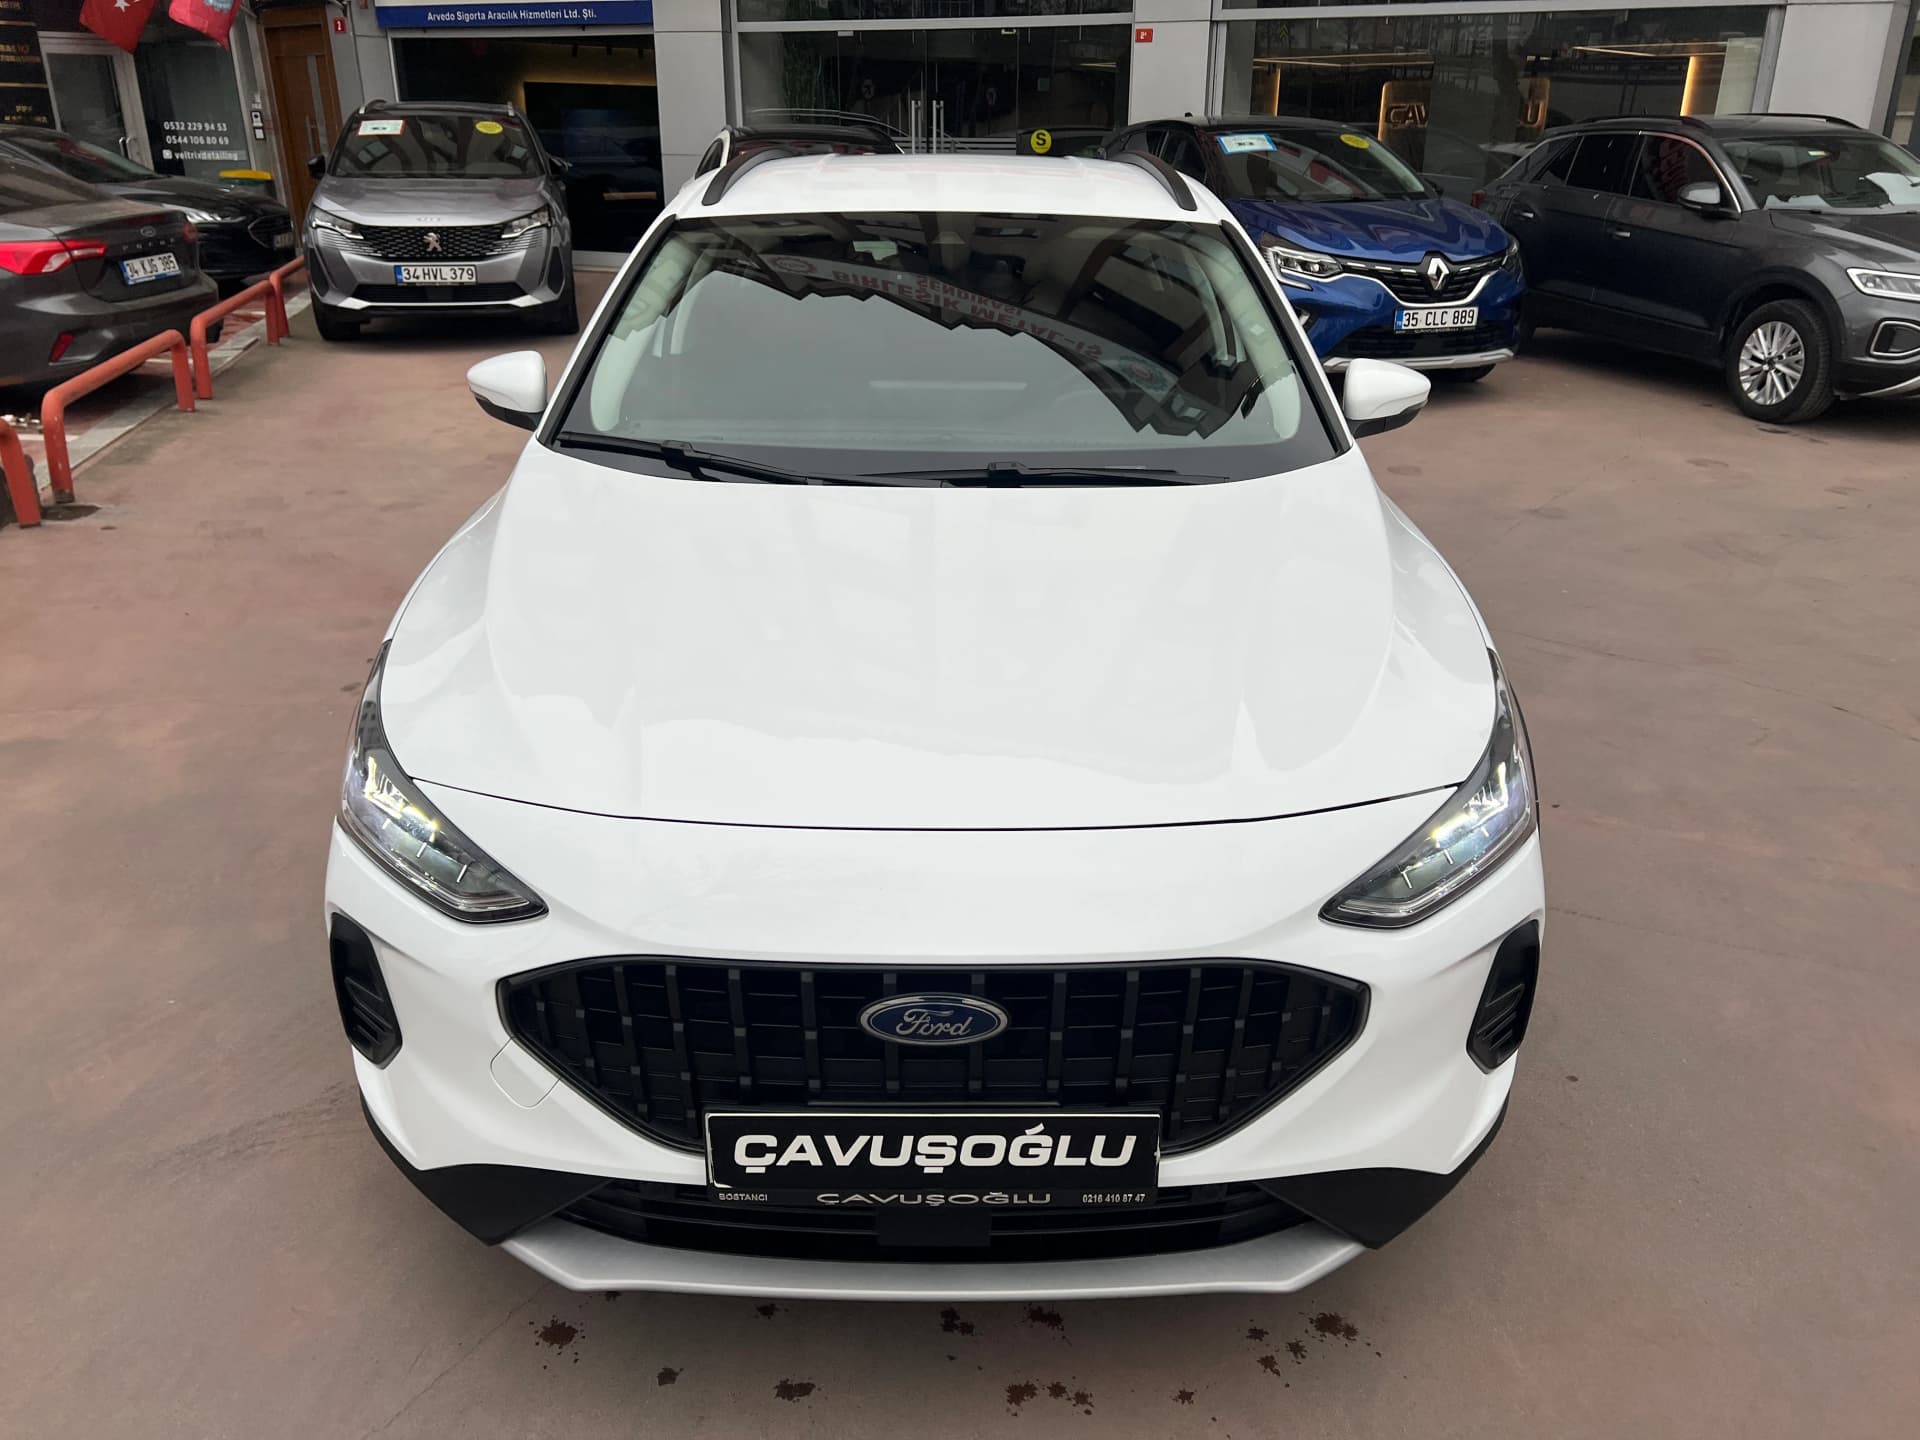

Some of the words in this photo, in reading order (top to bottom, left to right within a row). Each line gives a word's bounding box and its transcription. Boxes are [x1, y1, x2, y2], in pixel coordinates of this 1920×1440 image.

[427, 11, 455, 21] Arvedo
[456, 10, 486, 22] Sigorta
[487, 9, 519, 20] Aracılık
[519, 9, 562, 20] Hizmetleri
[563, 8, 581, 19] Ltd.
[582, 8, 598, 20] Şti.
[163, 121, 185, 131] 0532
[187, 122, 203, 131] 229
[204, 123, 216, 132] 94
[165, 135, 188, 145] 0544
[189, 135, 205, 145] 106
[1036, 132, 1047, 147] S
[126, 261, 140, 278] 34
[403, 267, 420, 281] 34
[422, 267, 448, 281] HVL
[449, 267, 474, 281] 379
[1403, 312, 1418, 327] 35
[1425, 311, 1448, 326] CLC
[1452, 309, 1475, 325] 889
[896, 1008, 973, 1036] Ford
[733, 1123, 1137, 1174] ÇAVUŞOĞLU
[718, 1193, 768, 1201] BOSTANCI
[816, 1191, 1051, 1206] ÇAVUŞOĞLU
[1082, 1193, 1103, 1203] 0216
[1105, 1193, 1120, 1203] 410
[1134, 1193, 1146, 1202] 47
